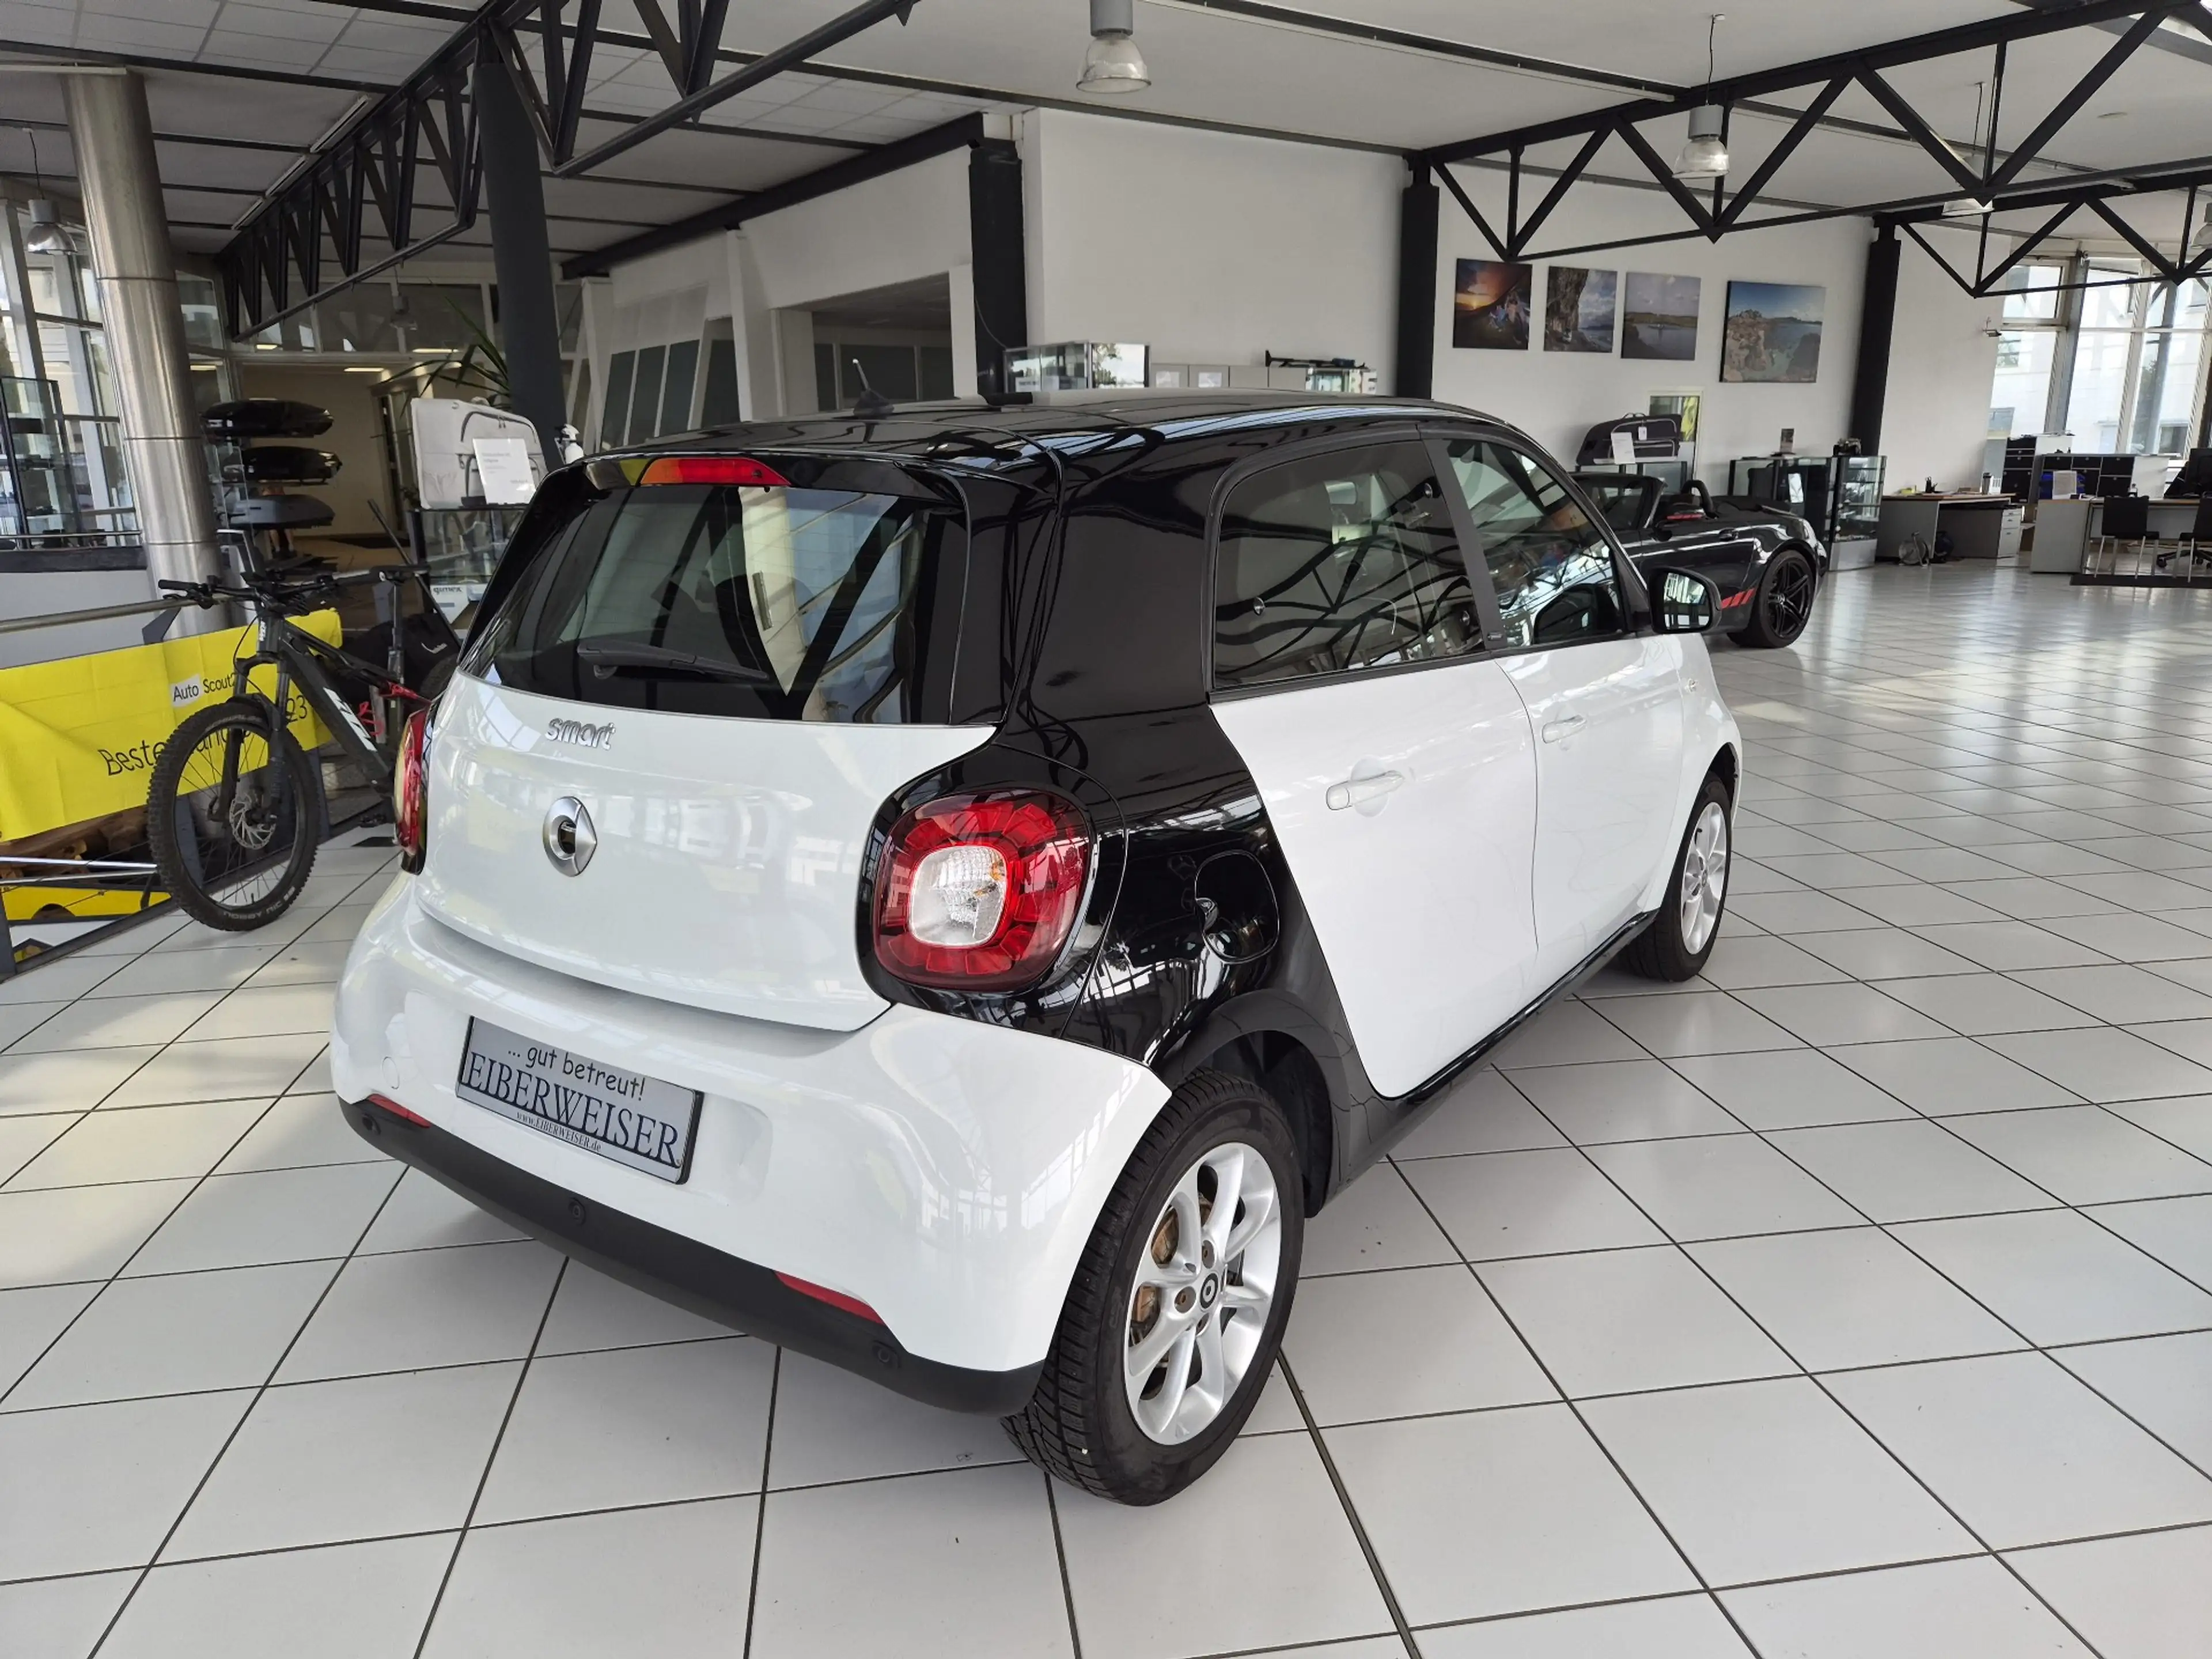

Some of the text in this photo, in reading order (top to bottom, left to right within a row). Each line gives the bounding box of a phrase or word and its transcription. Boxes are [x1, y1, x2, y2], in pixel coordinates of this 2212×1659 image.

[173, 672, 236, 702] Auto Scout2
[544, 717, 616, 751] smart
[525, 1047, 557, 1070] gut
[562, 1051, 645, 1101] betreut!
[464, 1051, 681, 1169] EIBERWEISER
[517, 1112, 601, 1152] www.EIBERWEISER.de
